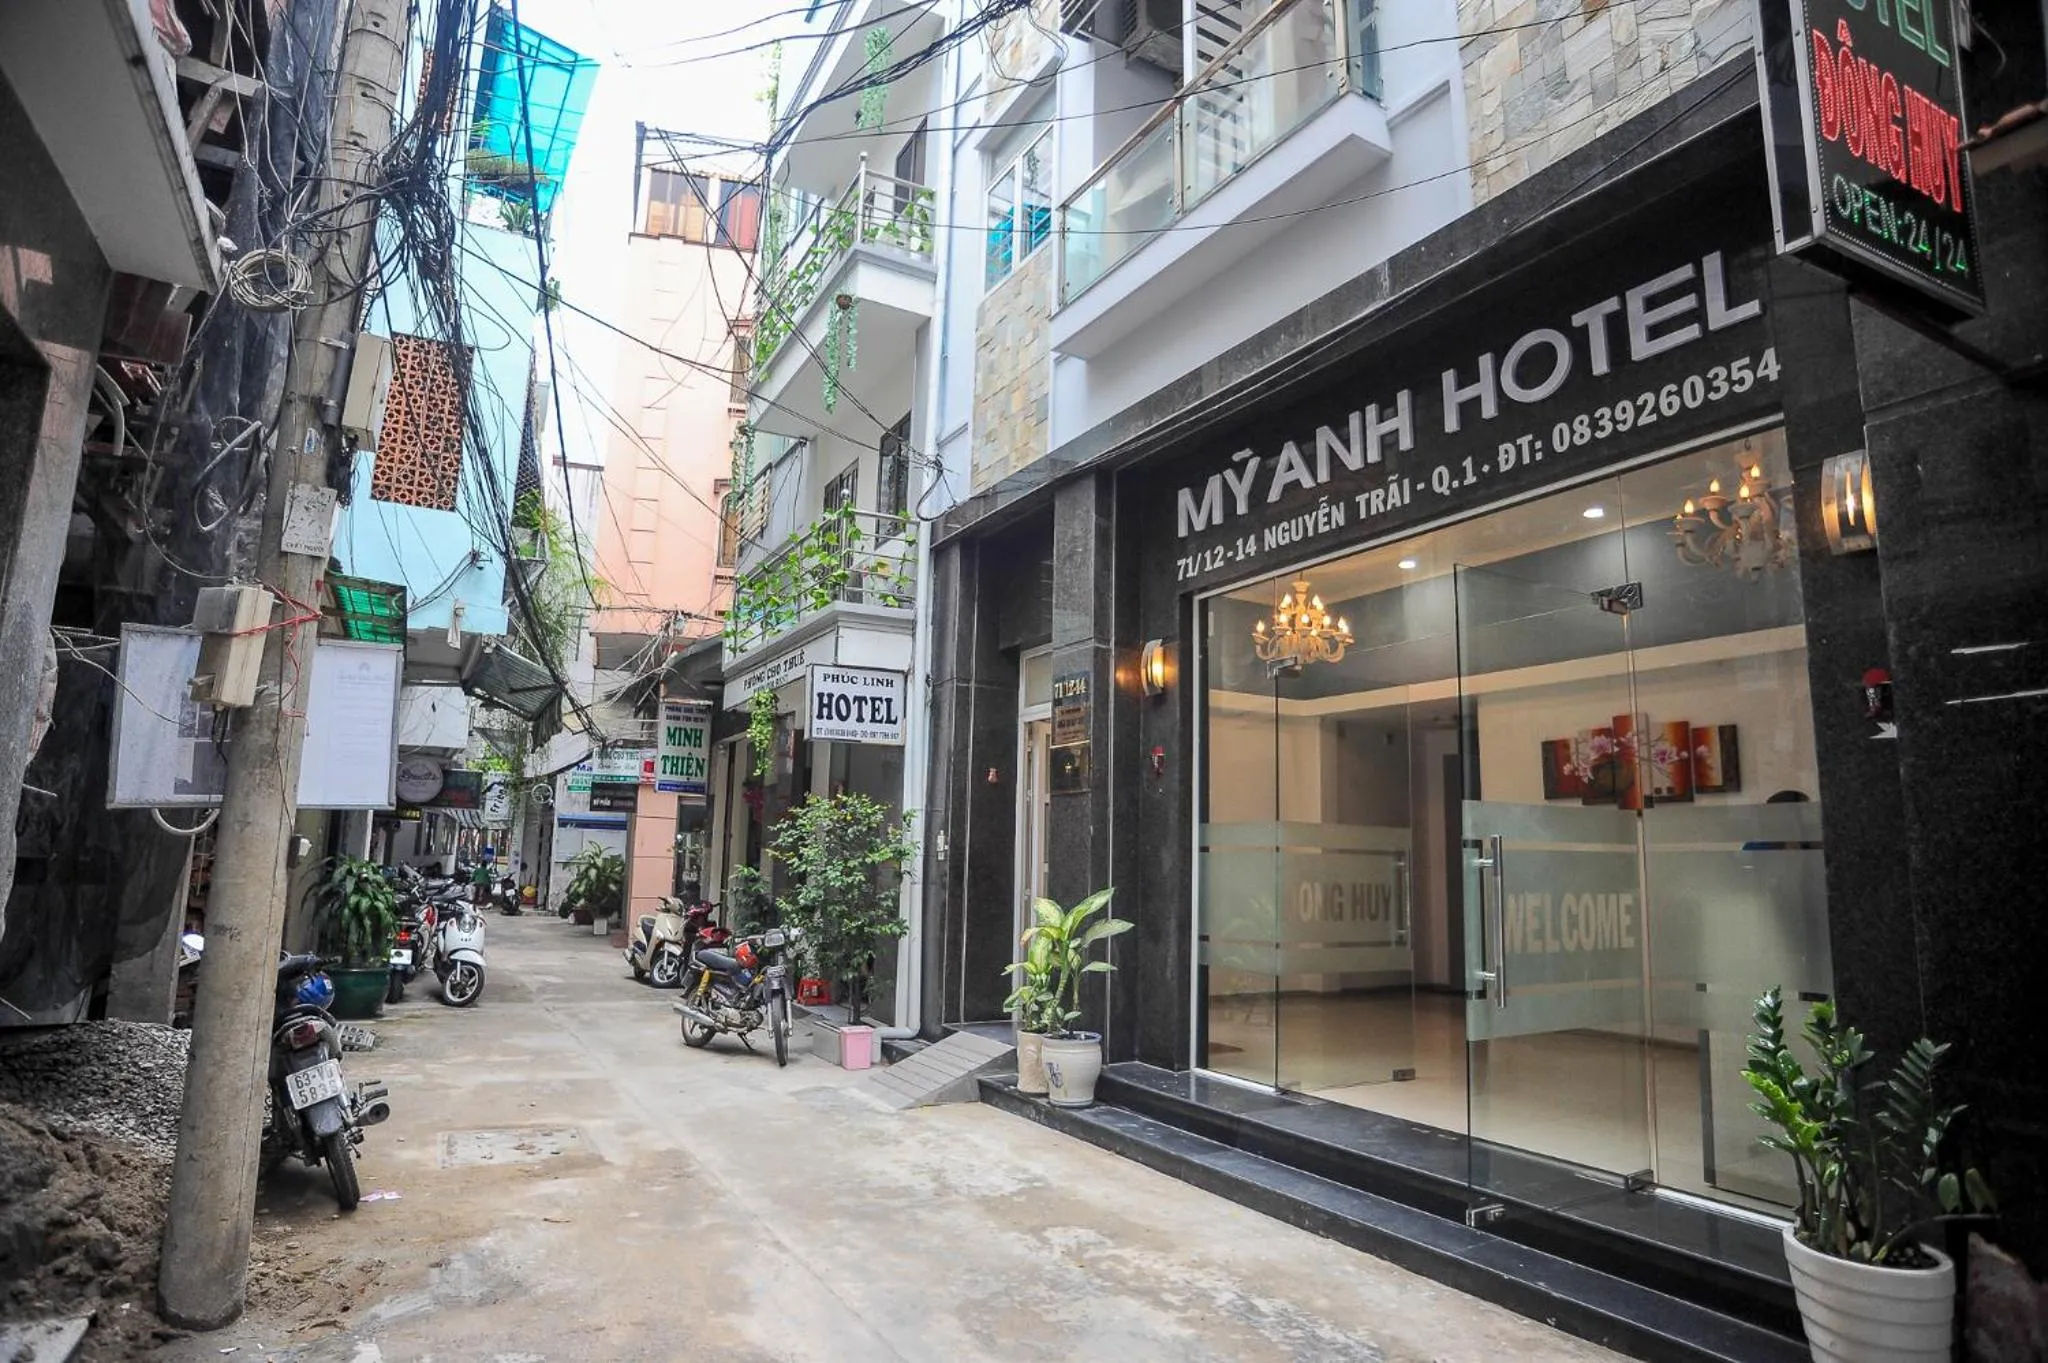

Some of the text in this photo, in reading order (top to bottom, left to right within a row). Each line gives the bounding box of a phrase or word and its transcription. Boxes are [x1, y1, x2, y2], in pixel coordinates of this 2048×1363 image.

[1846, 0, 1950, 68] EL
[1904, 84, 1962, 213] HUY
[1177, 248, 1762, 538] MỸ ANH HOTEL
[1176, 533, 1257, 582] 71/12-14
[1263, 495, 1346, 552] NGUYỄN
[1355, 472, 1411, 520] TRÃI
[1498, 433, 1543, 474] ĐT:
[1552, 346, 1782, 453] 0839260354
[783, 648, 805, 673] THUÊ
[822, 670, 895, 688] PHÚC LINH
[816, 692, 898, 725] HOTEL
[666, 726, 704, 748] MINH
[661, 752, 705, 781] THIỆN
[1352, 881, 1393, 922] HUY
[1505, 891, 1636, 955] WELCOME
